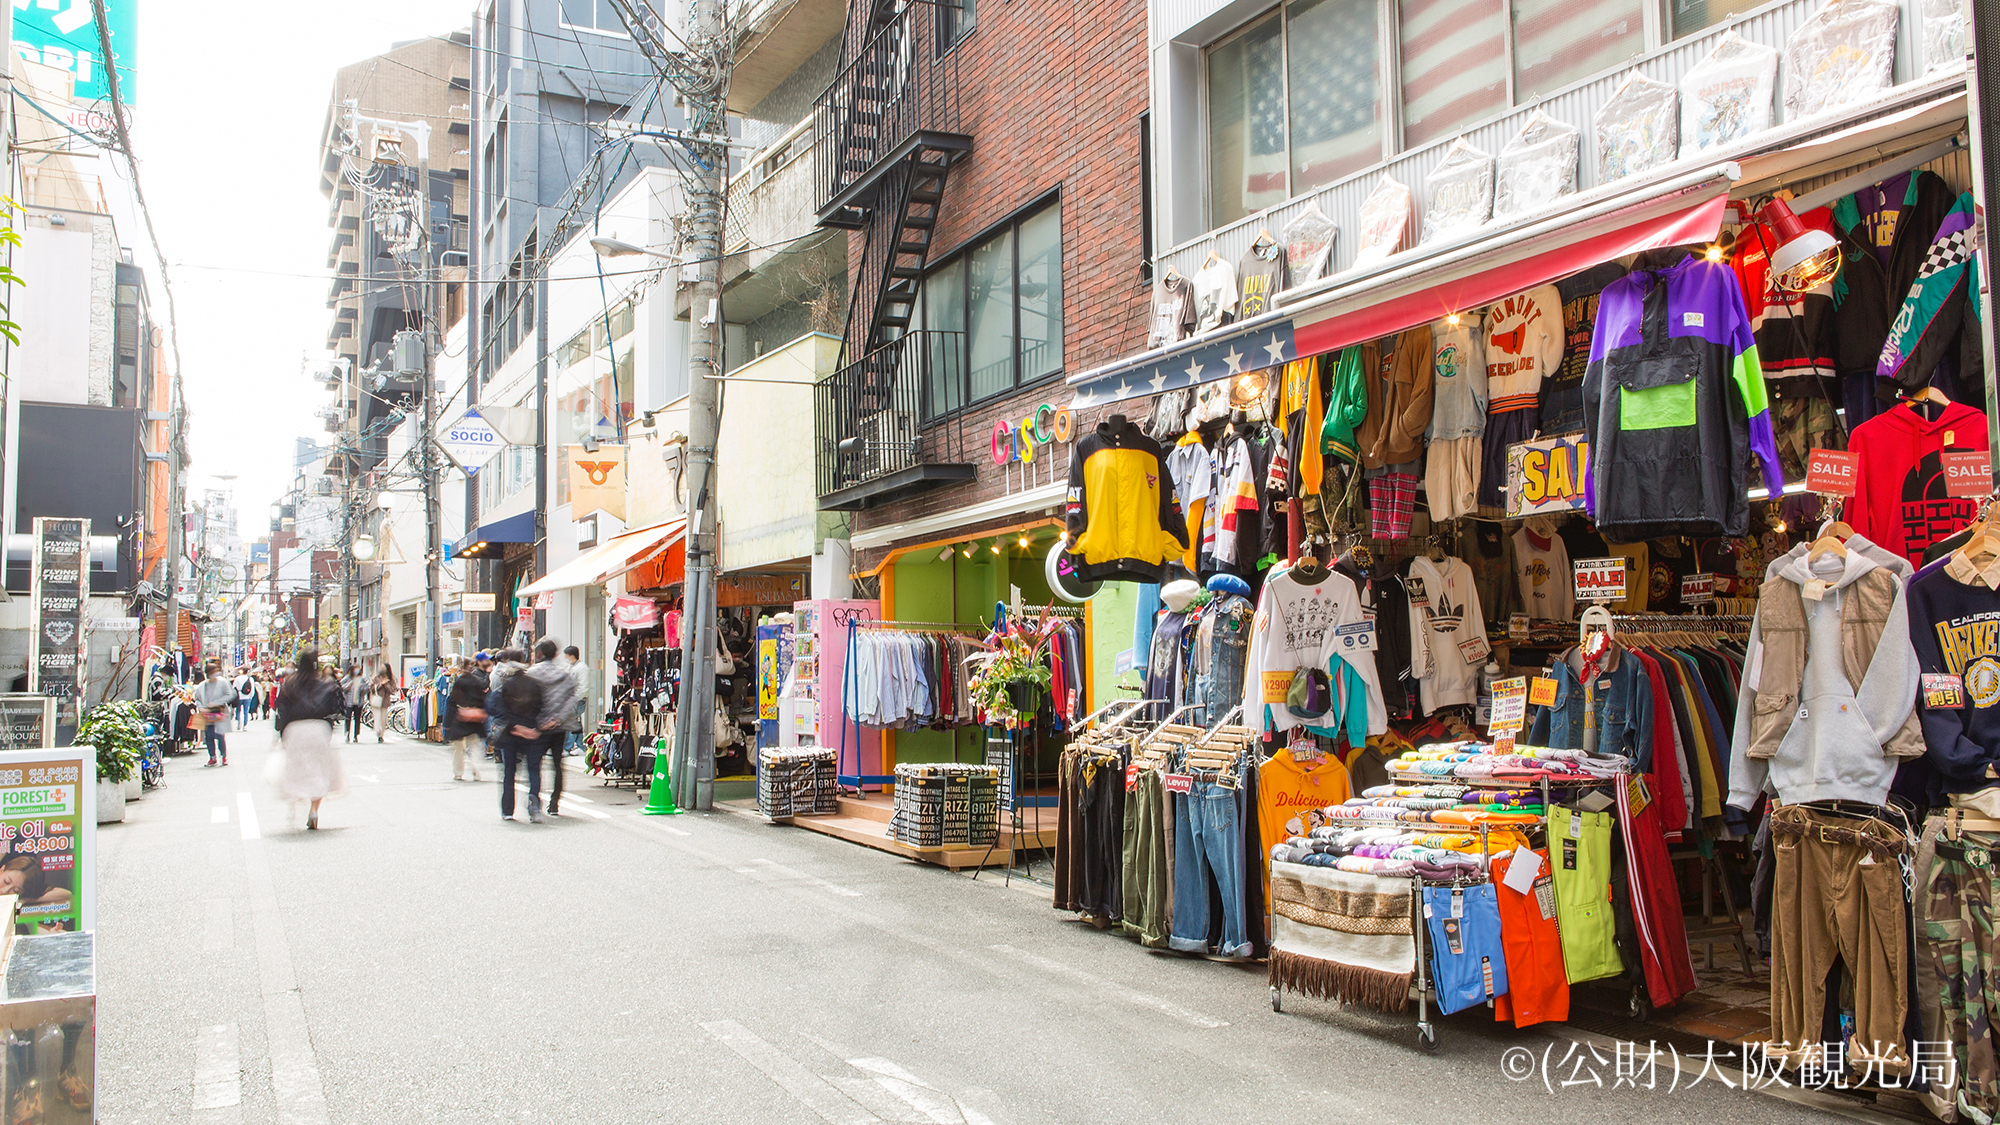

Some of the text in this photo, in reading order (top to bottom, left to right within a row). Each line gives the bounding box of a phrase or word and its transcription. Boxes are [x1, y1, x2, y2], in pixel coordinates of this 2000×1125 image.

[451, 431, 493, 442] SOCIO
[992, 403, 1077, 465] CISCO
[1812, 462, 1851, 477] SALE
[1948, 463, 1991, 478] SALE
[49, 523, 78, 532] PREVIEW
[1902, 503, 1926, 560] THE
[42, 574, 78, 582] TIGER
[1576, 570, 1625, 588] SALE!
[720, 579, 772, 592] TENSHINO
[1682, 581, 1713, 595] SALE!
[536, 592, 554, 608] SALE
[755, 590, 799, 603] TSUBASA
[41, 602, 78, 610] TIGER
[39, 659, 76, 667] TIGER
[1264, 679, 1291, 690] ¥2900
[1928, 690, 1961, 707] 割引
[3, 789, 50, 805] FOREST
[1275, 790, 1335, 808] Delicious
[5, 803, 64, 815] Relaxation House
[21, 820, 44, 838] Oil
[15, 836, 69, 854] ¥3,800
[40, 902, 69, 912] equipped
